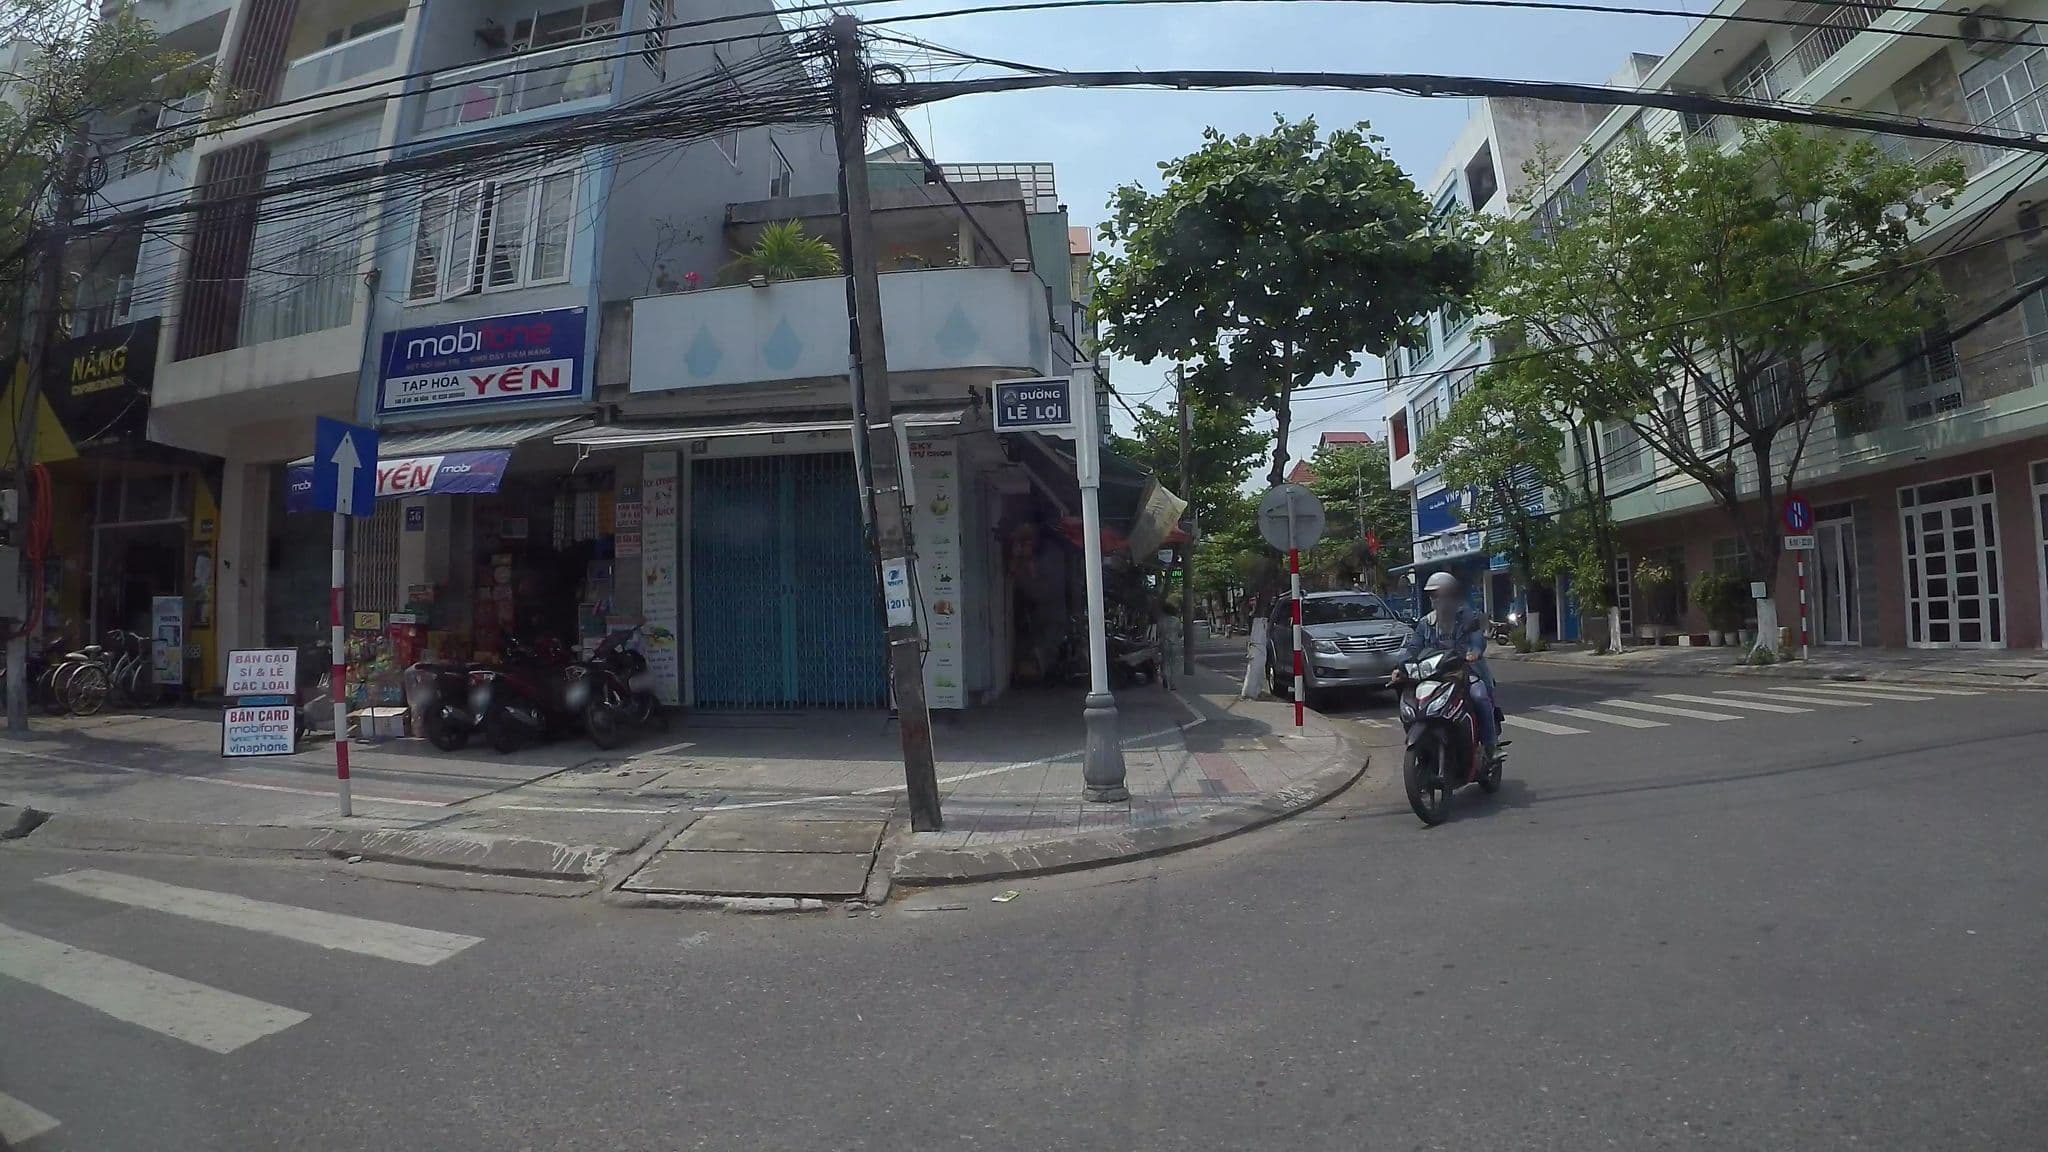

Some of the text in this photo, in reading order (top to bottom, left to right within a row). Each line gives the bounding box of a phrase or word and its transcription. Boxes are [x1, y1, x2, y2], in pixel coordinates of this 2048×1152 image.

[406, 320, 550, 360] mobifone
[402, 364, 560, 396] TẠP HÓA YẾN
[1020, 388, 1061, 401] ĐƯỜNG
[1007, 403, 1062, 422] LÊ LỢI
[377, 459, 435, 493] YẾN
[265, 654, 290, 665] GẠO
[256, 667, 265, 677] &
[262, 680, 290, 692] LOẠI
[258, 709, 290, 722] CARD
[229, 722, 288, 734] mobifone
[229, 742, 289, 754] vinaphone
